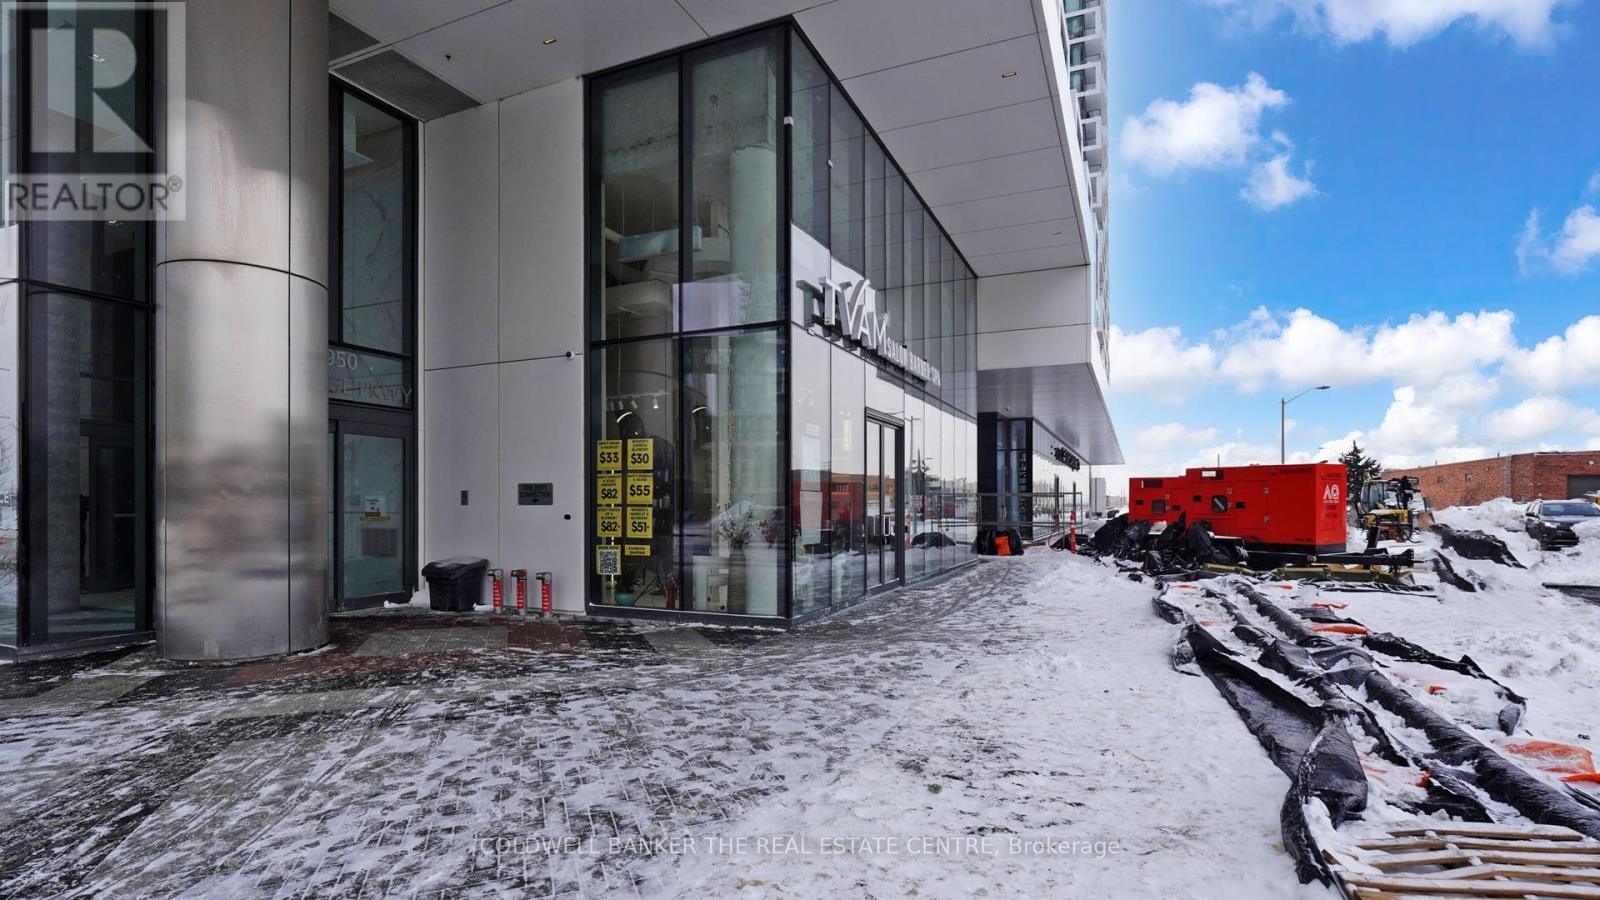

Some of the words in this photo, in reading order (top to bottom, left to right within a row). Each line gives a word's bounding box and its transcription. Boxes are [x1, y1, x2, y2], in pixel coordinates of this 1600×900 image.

[599, 450, 619, 464] $33
[630, 452, 649, 465] $30
[601, 487, 618, 500] $82
[629, 484, 651, 497] $55
